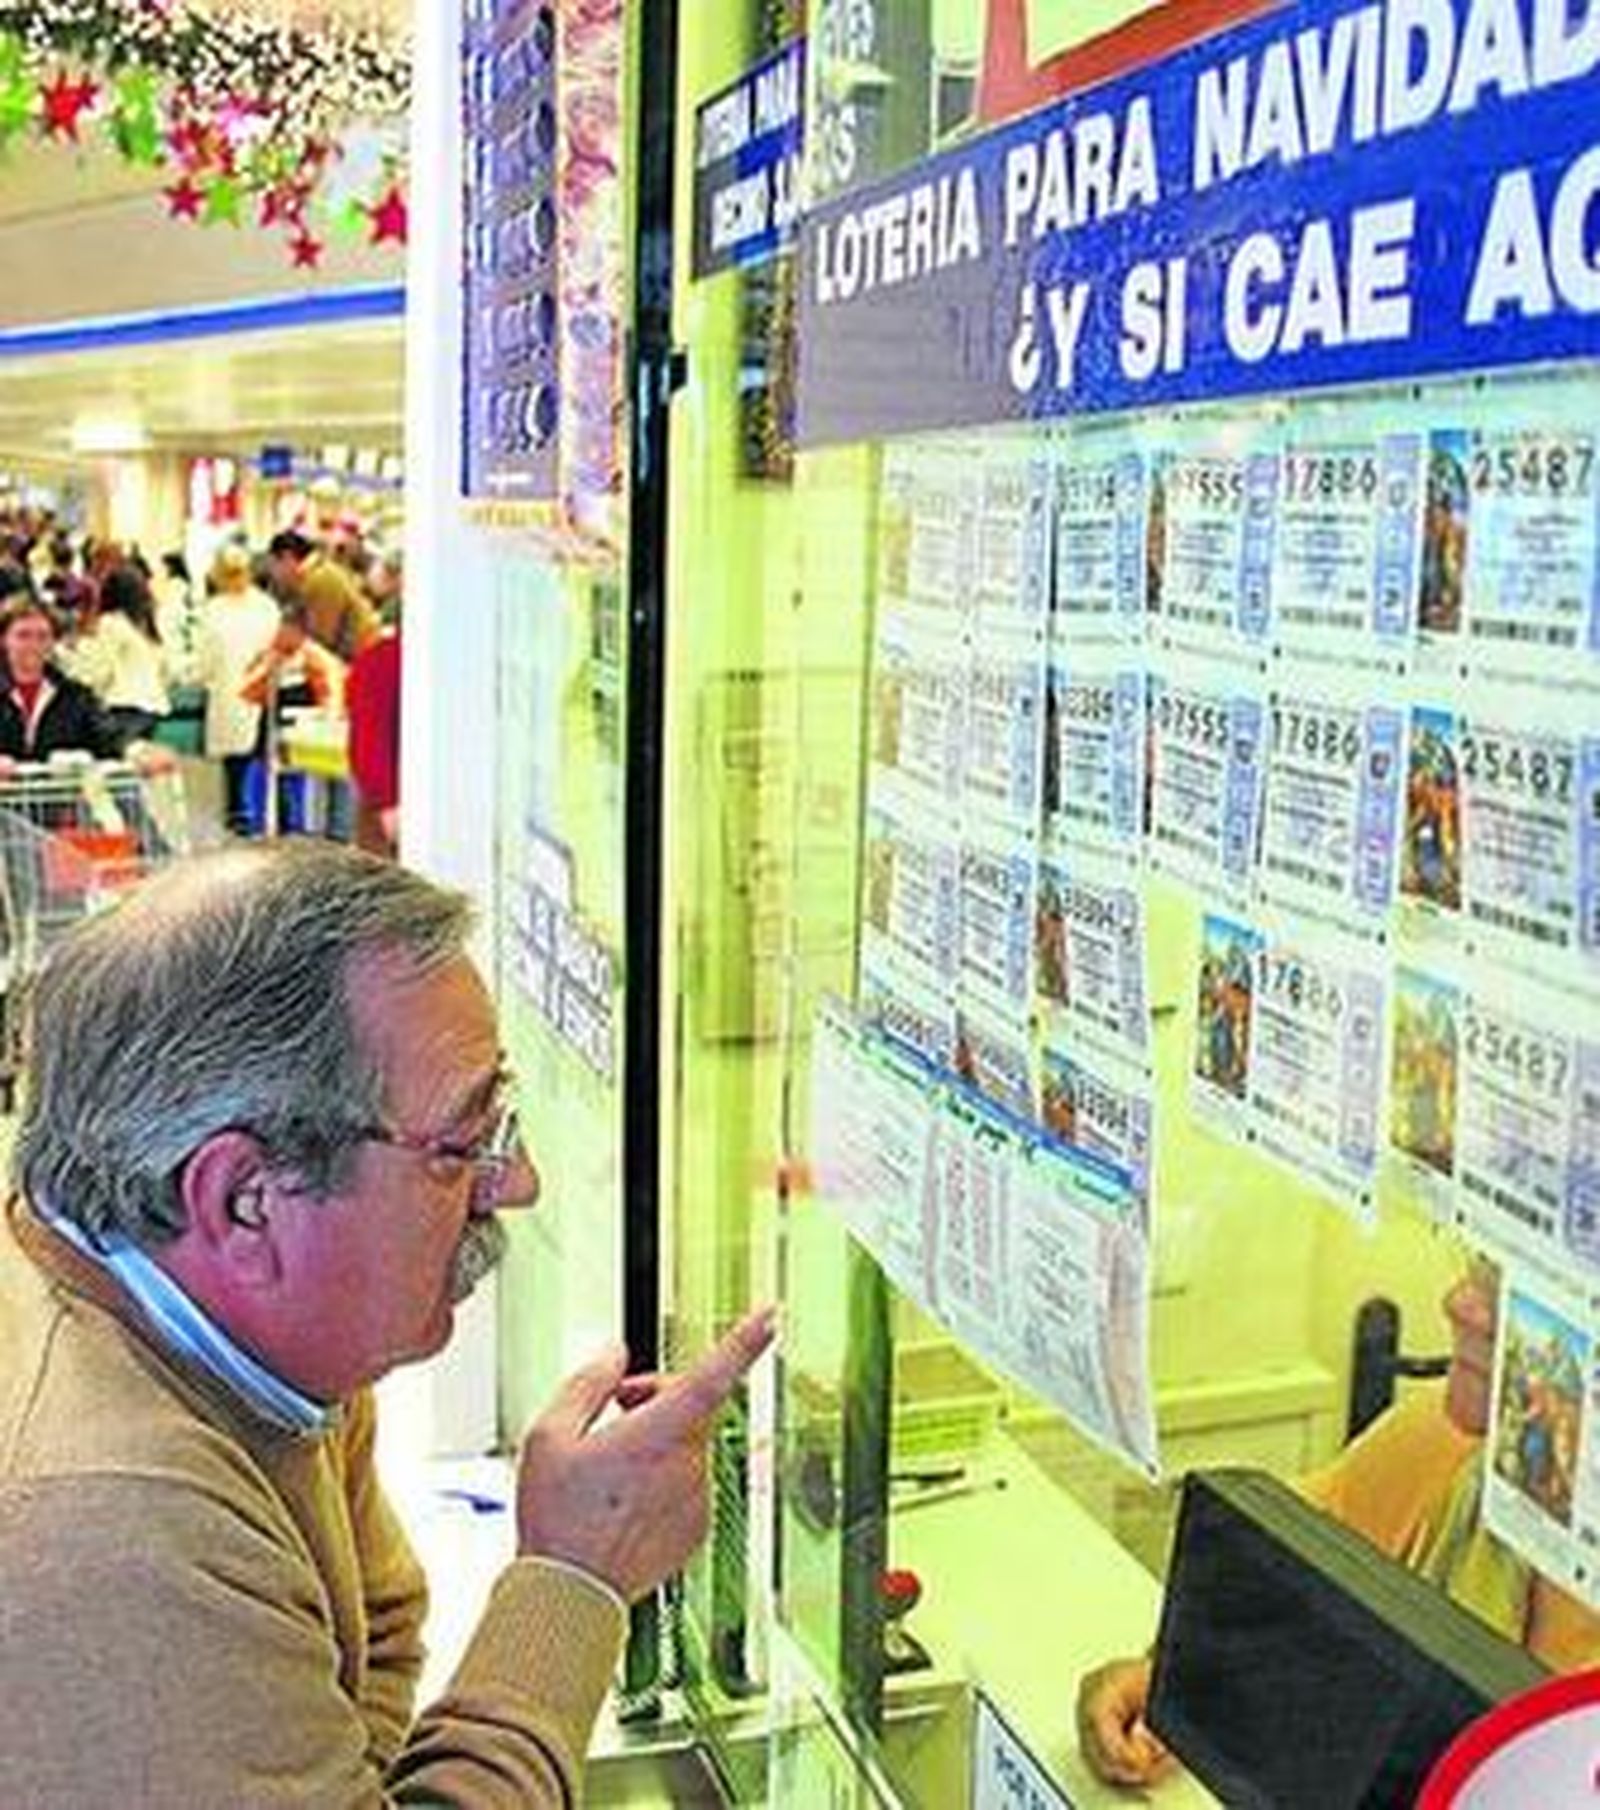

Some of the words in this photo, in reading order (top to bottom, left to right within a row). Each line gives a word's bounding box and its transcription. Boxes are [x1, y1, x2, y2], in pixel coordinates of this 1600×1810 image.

[815, 166, 981, 303] LOTERIA
[1004, 96, 1158, 246] PARA
[1193, 0, 1600, 191] NAVIDAD
[1009, 283, 1090, 392] ¿Y
[1119, 258, 1187, 380] SI
[1225, 199, 1416, 363] CAE
[1473, 447, 1594, 498] 25487
[1459, 736, 1574, 803] 25487
[1462, 1014, 1568, 1098] 25487
